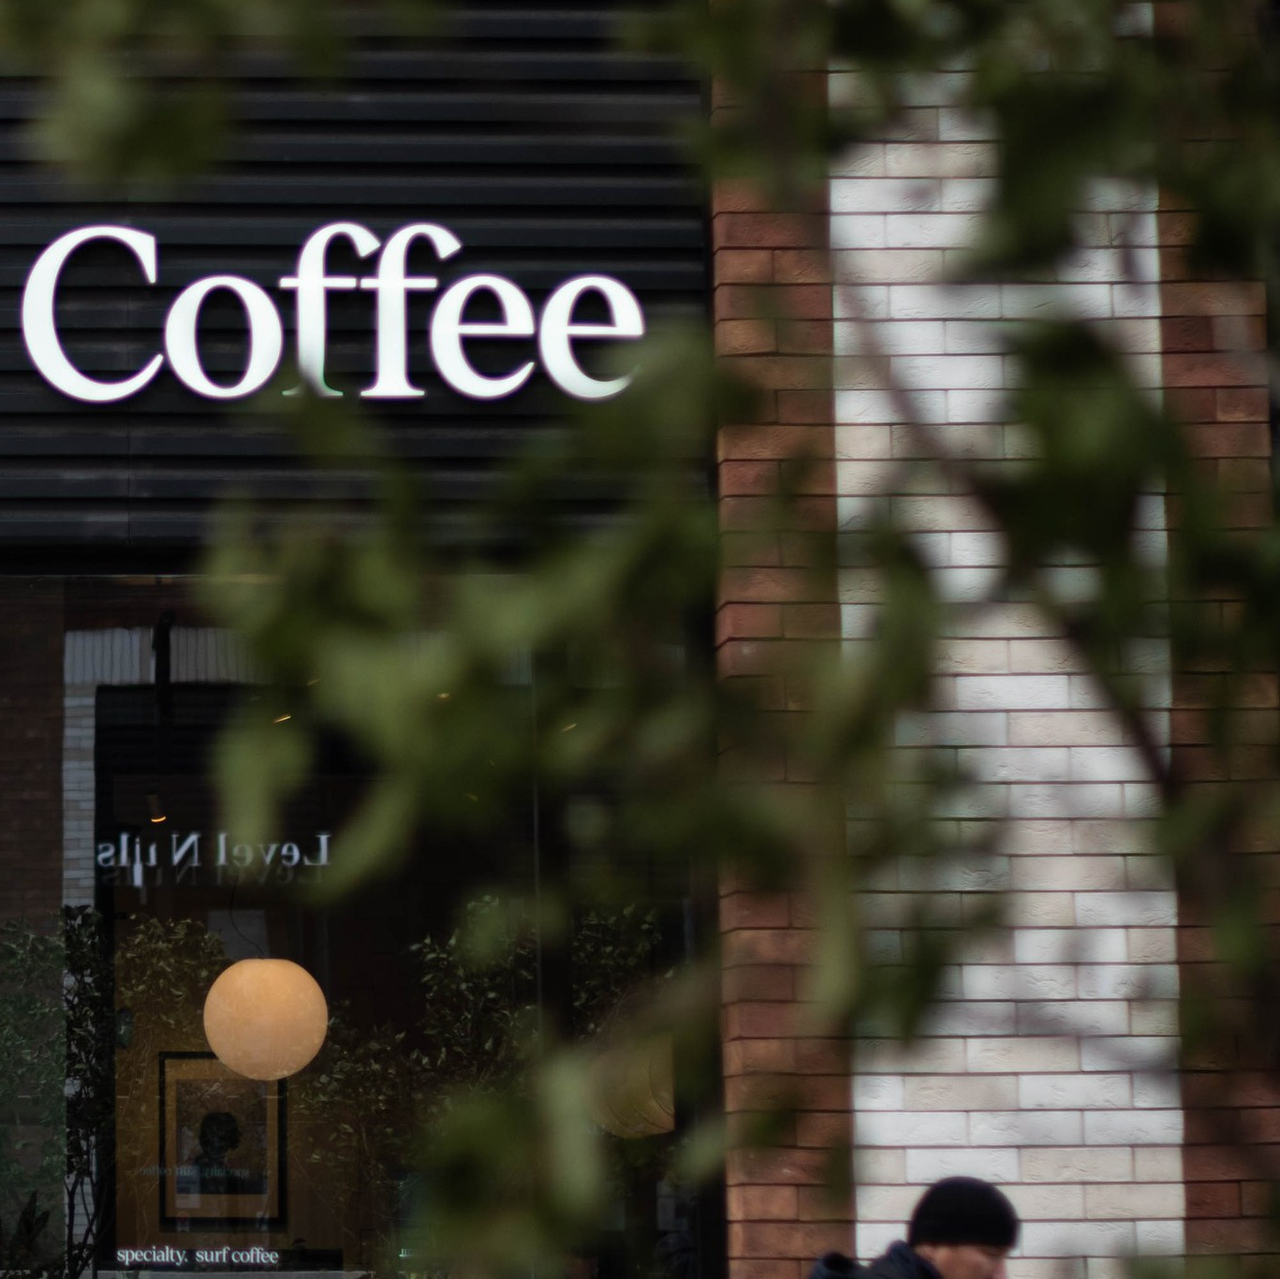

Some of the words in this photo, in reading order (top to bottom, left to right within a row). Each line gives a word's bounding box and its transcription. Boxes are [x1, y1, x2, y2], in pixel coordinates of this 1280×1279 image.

[21, 222, 644, 402] Coffee
[116, 1245, 188, 1266] specialty.
[195, 1246, 230, 1263] surf
[231, 1247, 279, 1264] coffee
